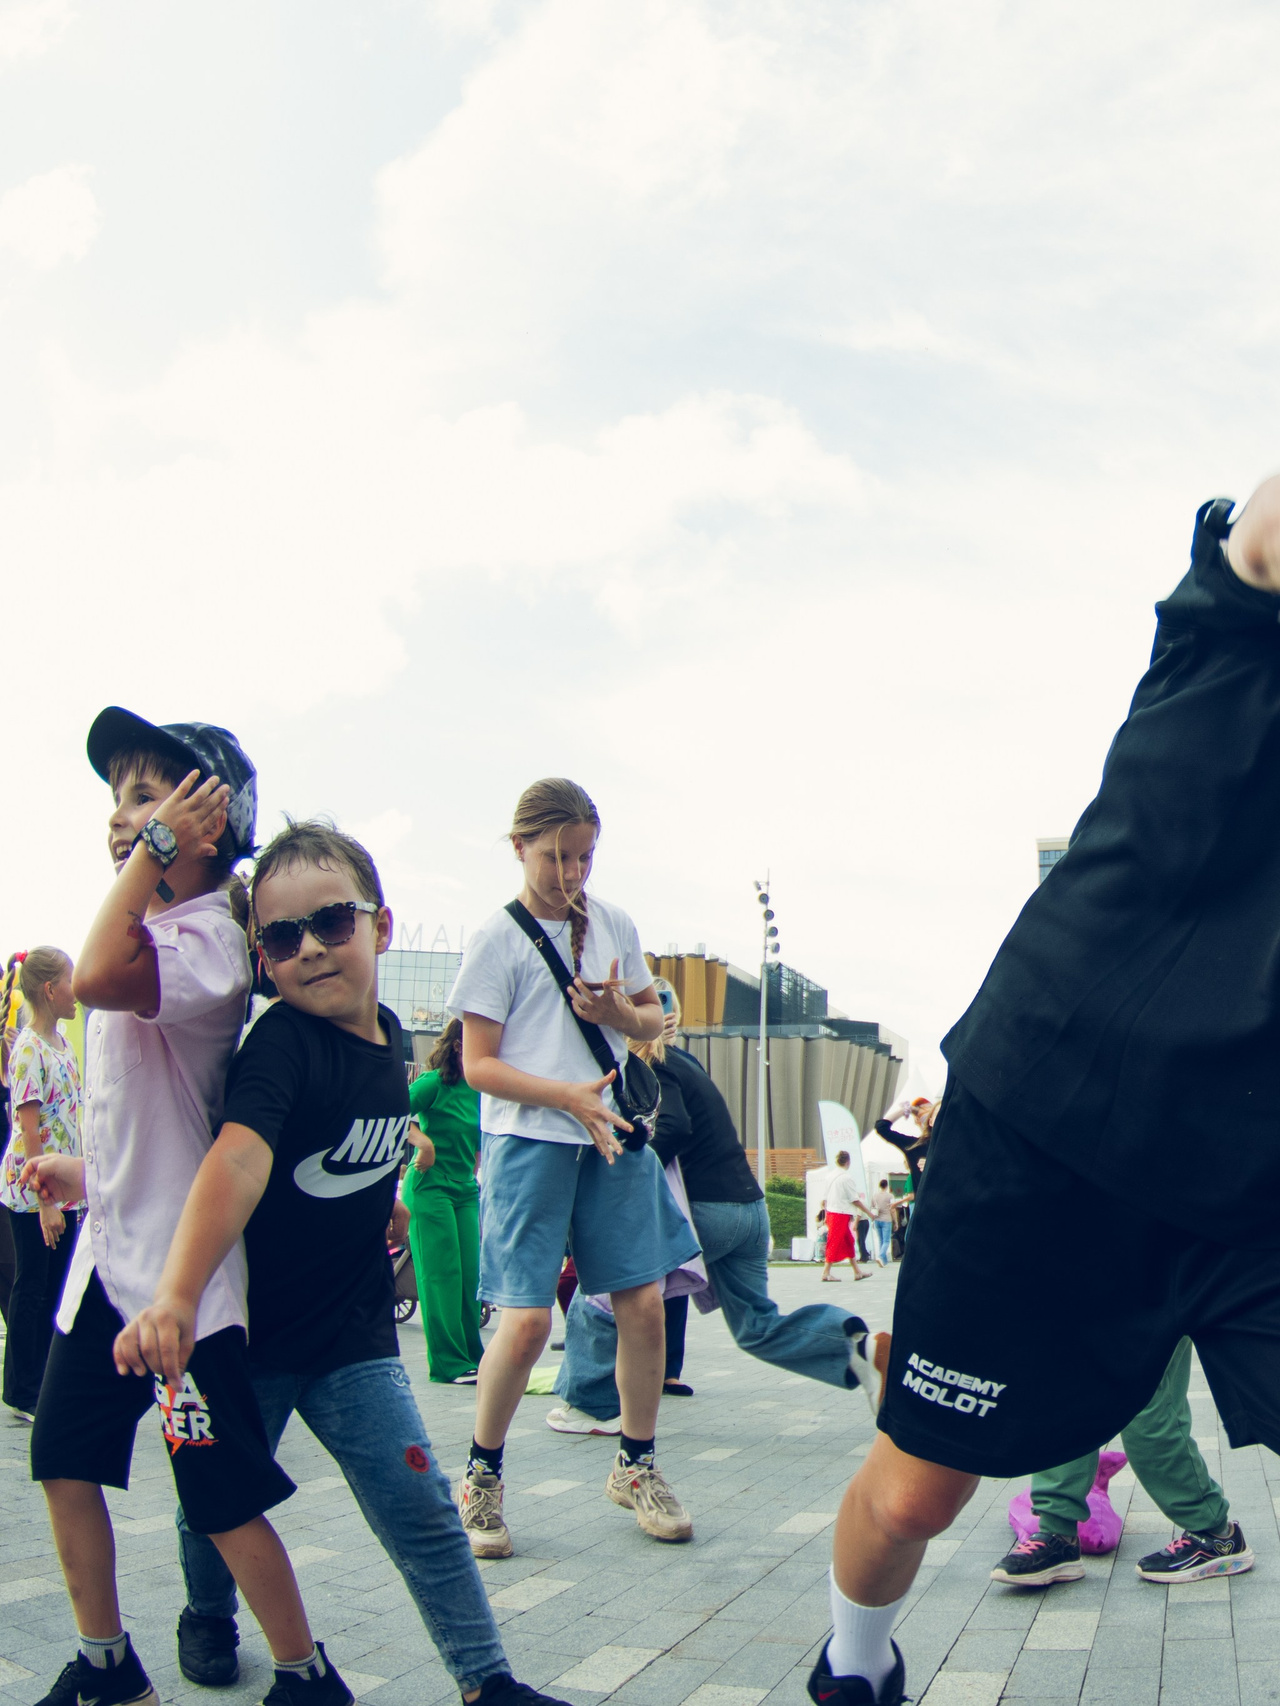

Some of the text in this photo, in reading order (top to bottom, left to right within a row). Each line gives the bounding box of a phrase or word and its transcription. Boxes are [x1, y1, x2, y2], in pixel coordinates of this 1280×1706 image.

[330, 1113, 411, 1163] NIKE
[902, 1370, 998, 1417] MOLOT
[907, 1352, 1007, 1398] ACADEMY
